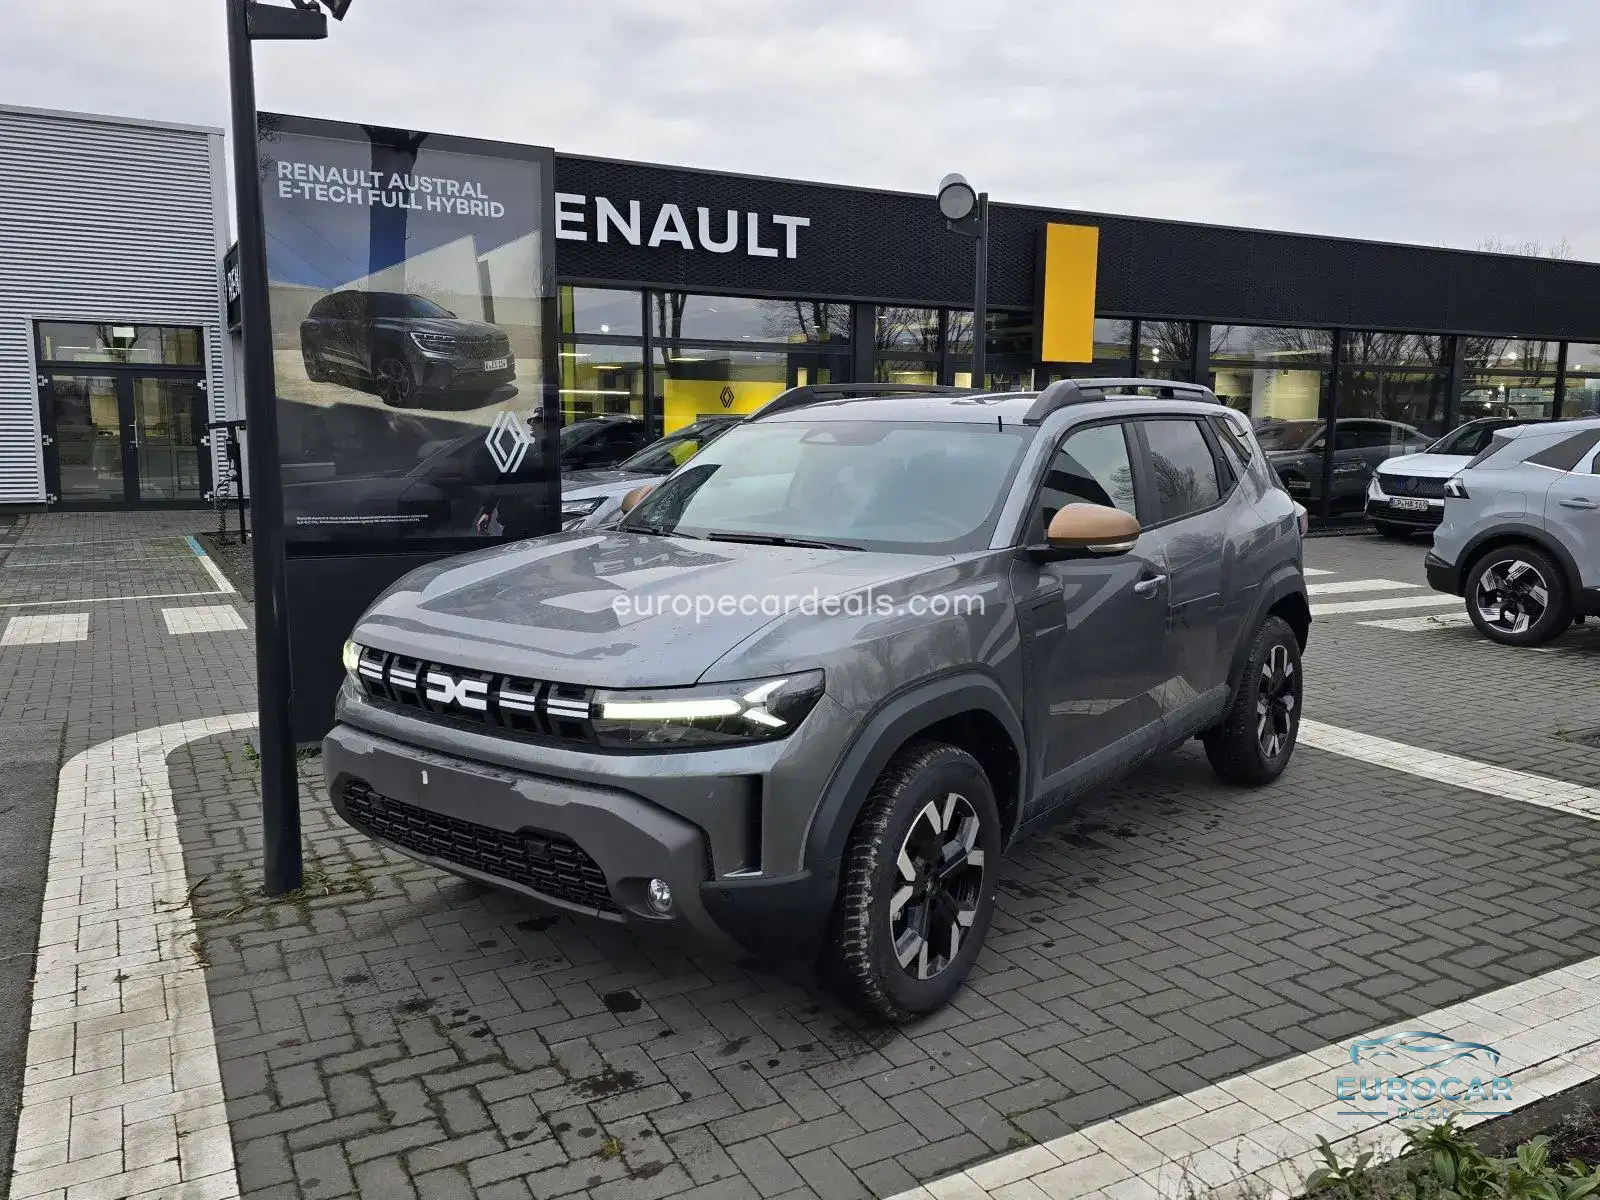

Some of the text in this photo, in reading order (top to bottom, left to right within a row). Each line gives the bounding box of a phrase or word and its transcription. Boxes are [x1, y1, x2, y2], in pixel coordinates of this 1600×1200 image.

[277, 160, 489, 199] RENAULT AUSTRAL
[278, 180, 505, 218] E-TECH FULL HYBRID
[554, 192, 810, 259] ENAULT
